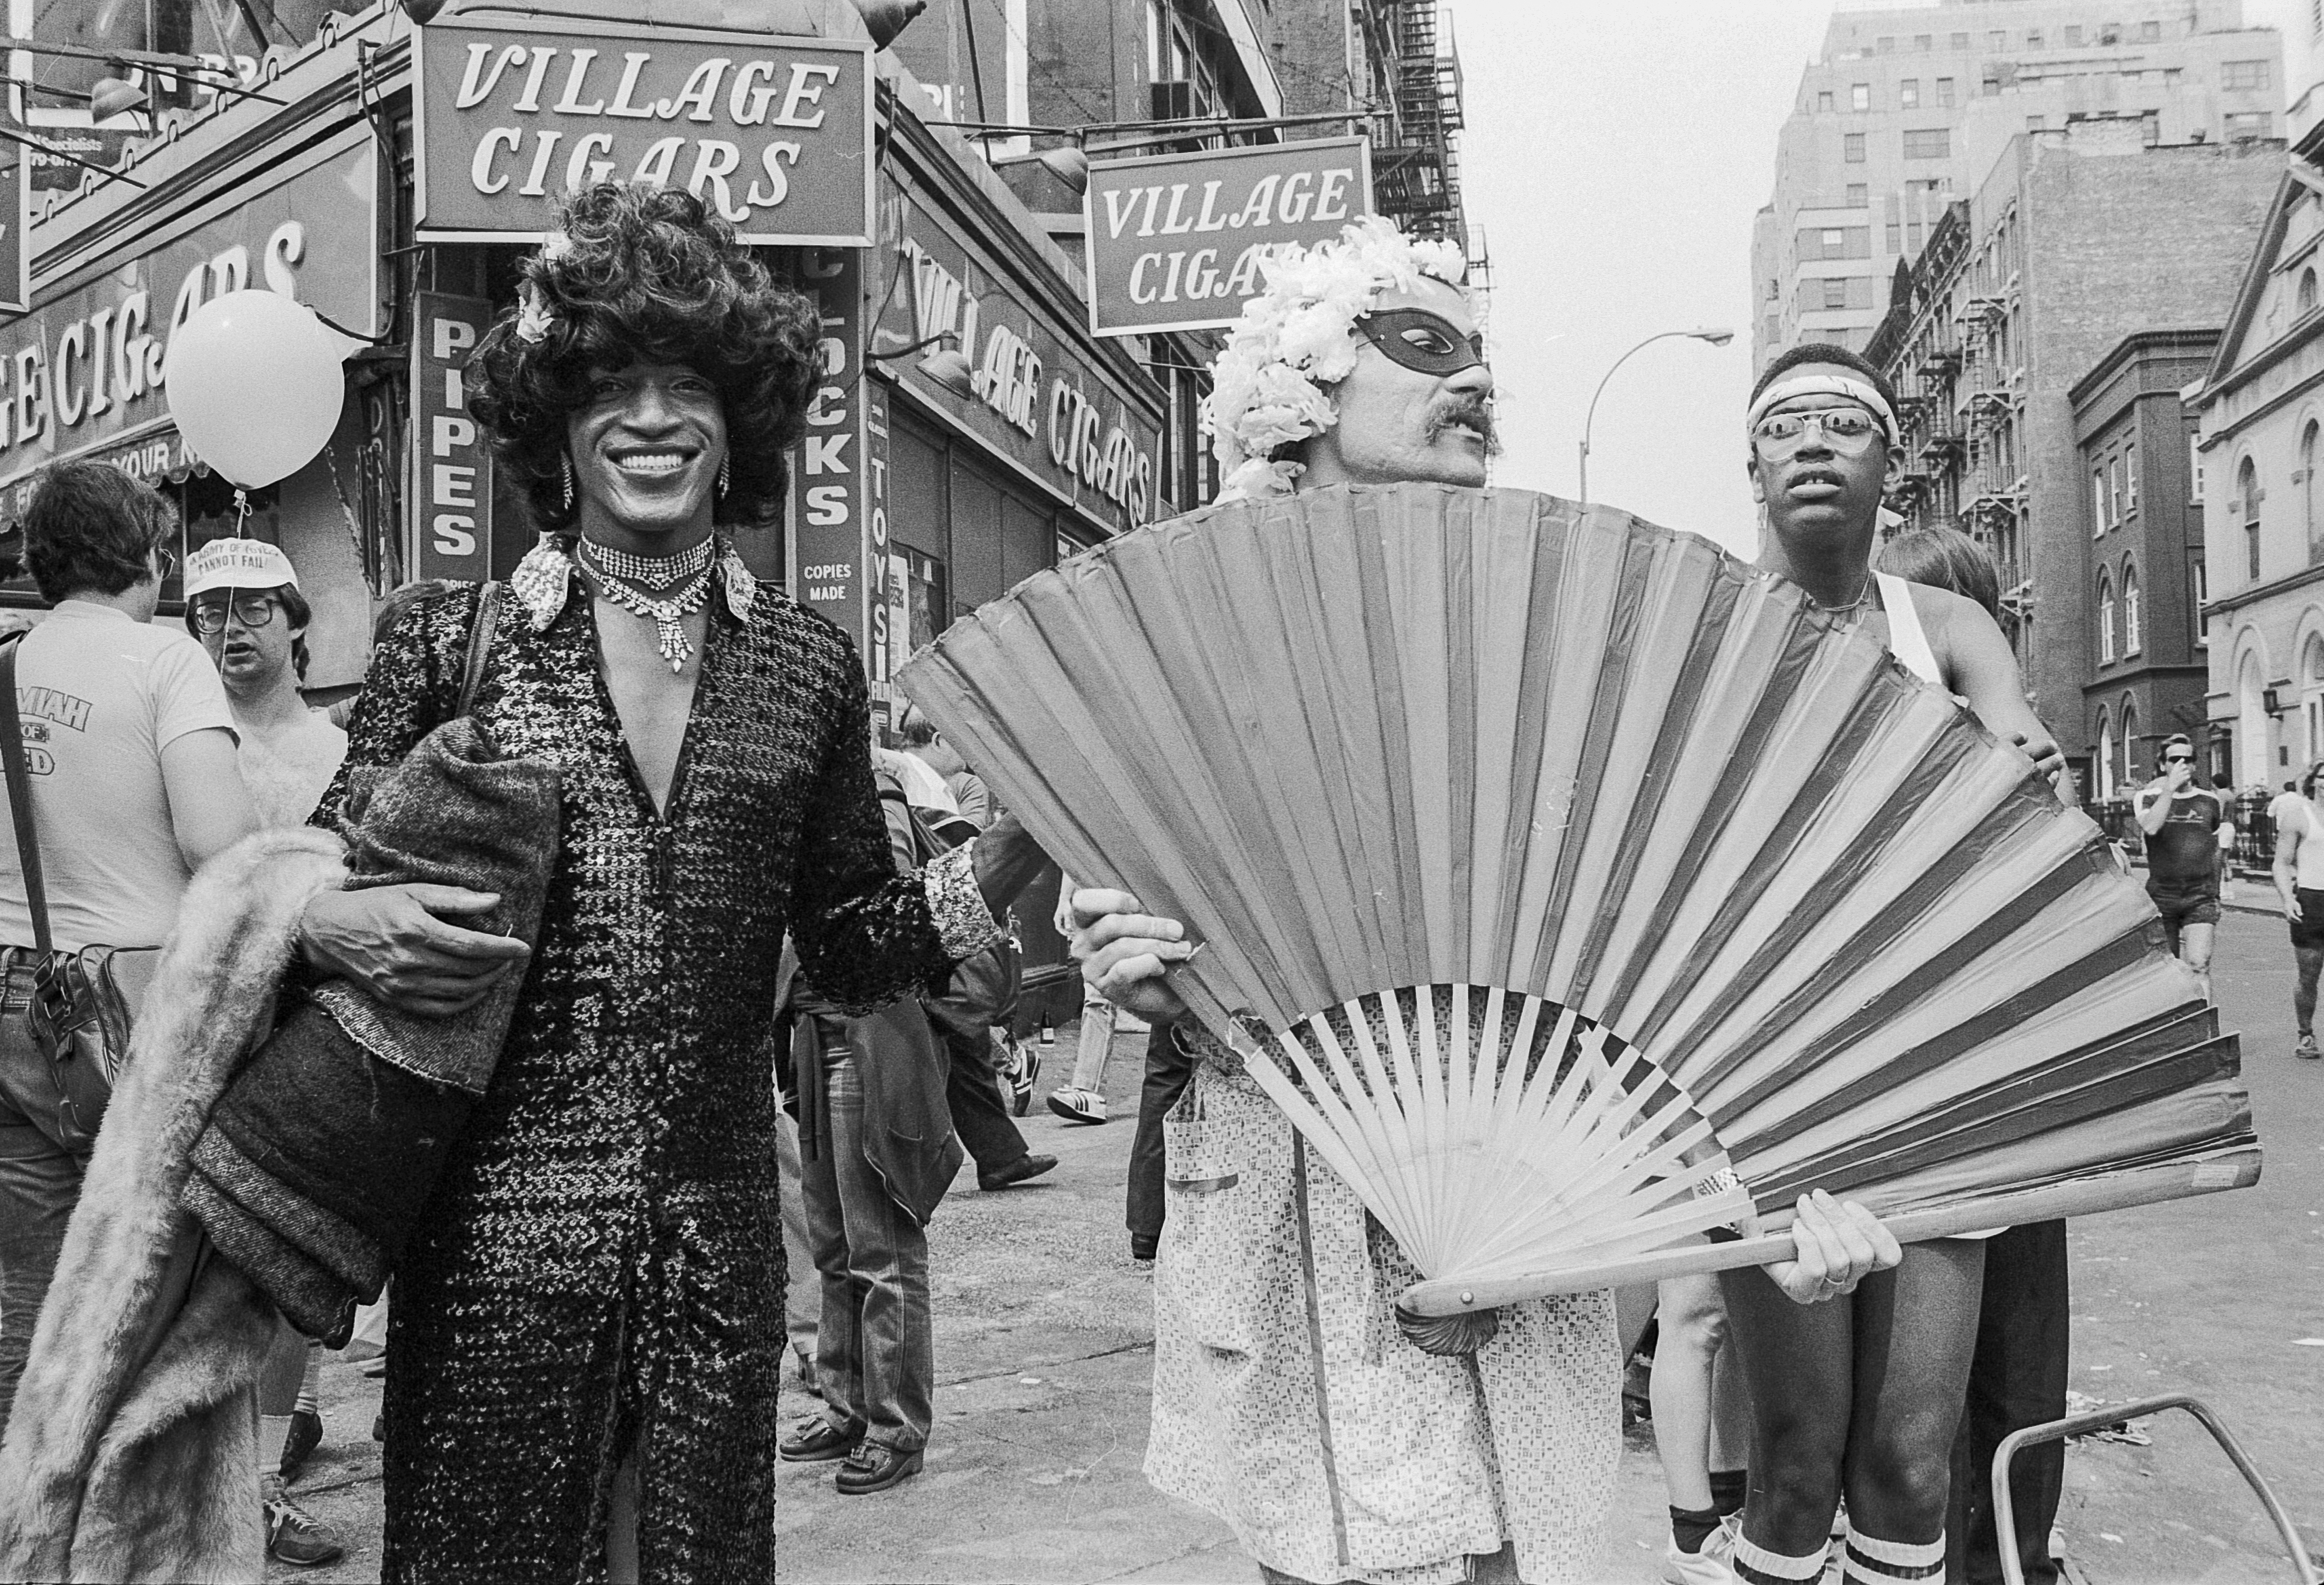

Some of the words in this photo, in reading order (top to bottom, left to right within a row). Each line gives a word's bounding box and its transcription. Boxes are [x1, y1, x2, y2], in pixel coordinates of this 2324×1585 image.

[455, 42, 841, 129] VILLAGE
[470, 127, 801, 222] CIGARS
[1103, 168, 1353, 240] VILLAGE
[1129, 239, 1339, 305] CIGA
[433, 318, 476, 556] PIPES
[198, 554, 237, 575] CANNOT
[804, 564, 851, 580] COPIES
[872, 457, 887, 644] TOYS
[810, 586, 846, 601] MADE
